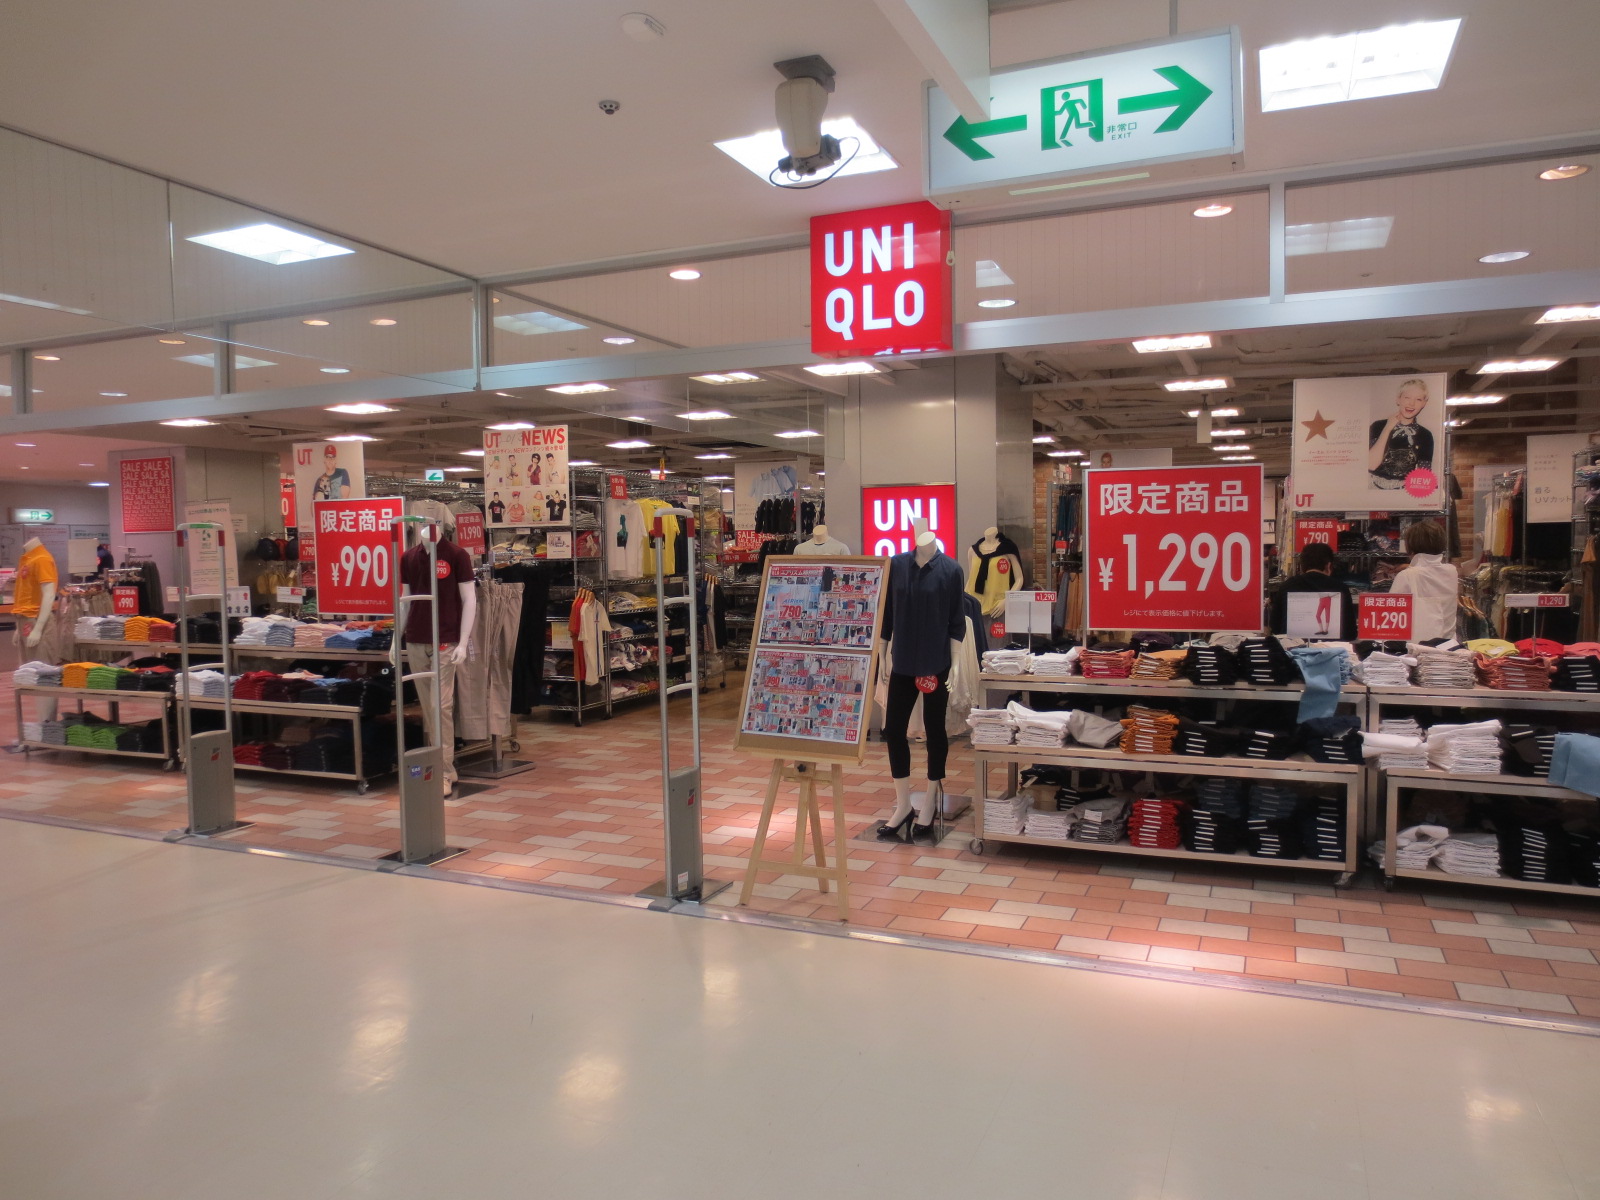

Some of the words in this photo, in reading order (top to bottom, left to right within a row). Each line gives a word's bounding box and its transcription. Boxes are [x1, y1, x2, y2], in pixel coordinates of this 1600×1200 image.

[1107, 122, 1137, 133] 非常口
[1112, 132, 1131, 140] EXIT
[825, 222, 914, 277] UNI
[825, 280, 925, 341] QLO
[485, 433, 502, 449] UT
[521, 428, 566, 446] NEWS
[297, 448, 313, 465] UT
[122, 462, 140, 472] SALE
[143, 461, 162, 471] SALE
[122, 471, 139, 480] SALE
[142, 470, 158, 479] SALE
[1410, 477, 1431, 486] NEW
[1100, 480, 1249, 516] 限定商品
[1296, 494, 1314, 507] UT
[319, 508, 394, 533] 限定商品
[874, 498, 938, 532] UNI
[1299, 521, 1334, 529] 限定商品
[1303, 532, 1329, 545] ¥790
[331, 544, 389, 587] ¥990
[1098, 532, 1251, 600] ¥1,290
[1036, 593, 1055, 601] ¥1,290
[1364, 597, 1407, 607] 限定商品
[1540, 595, 1563, 606] ¥1,290
[1363, 611, 1408, 630] ¥1,290
